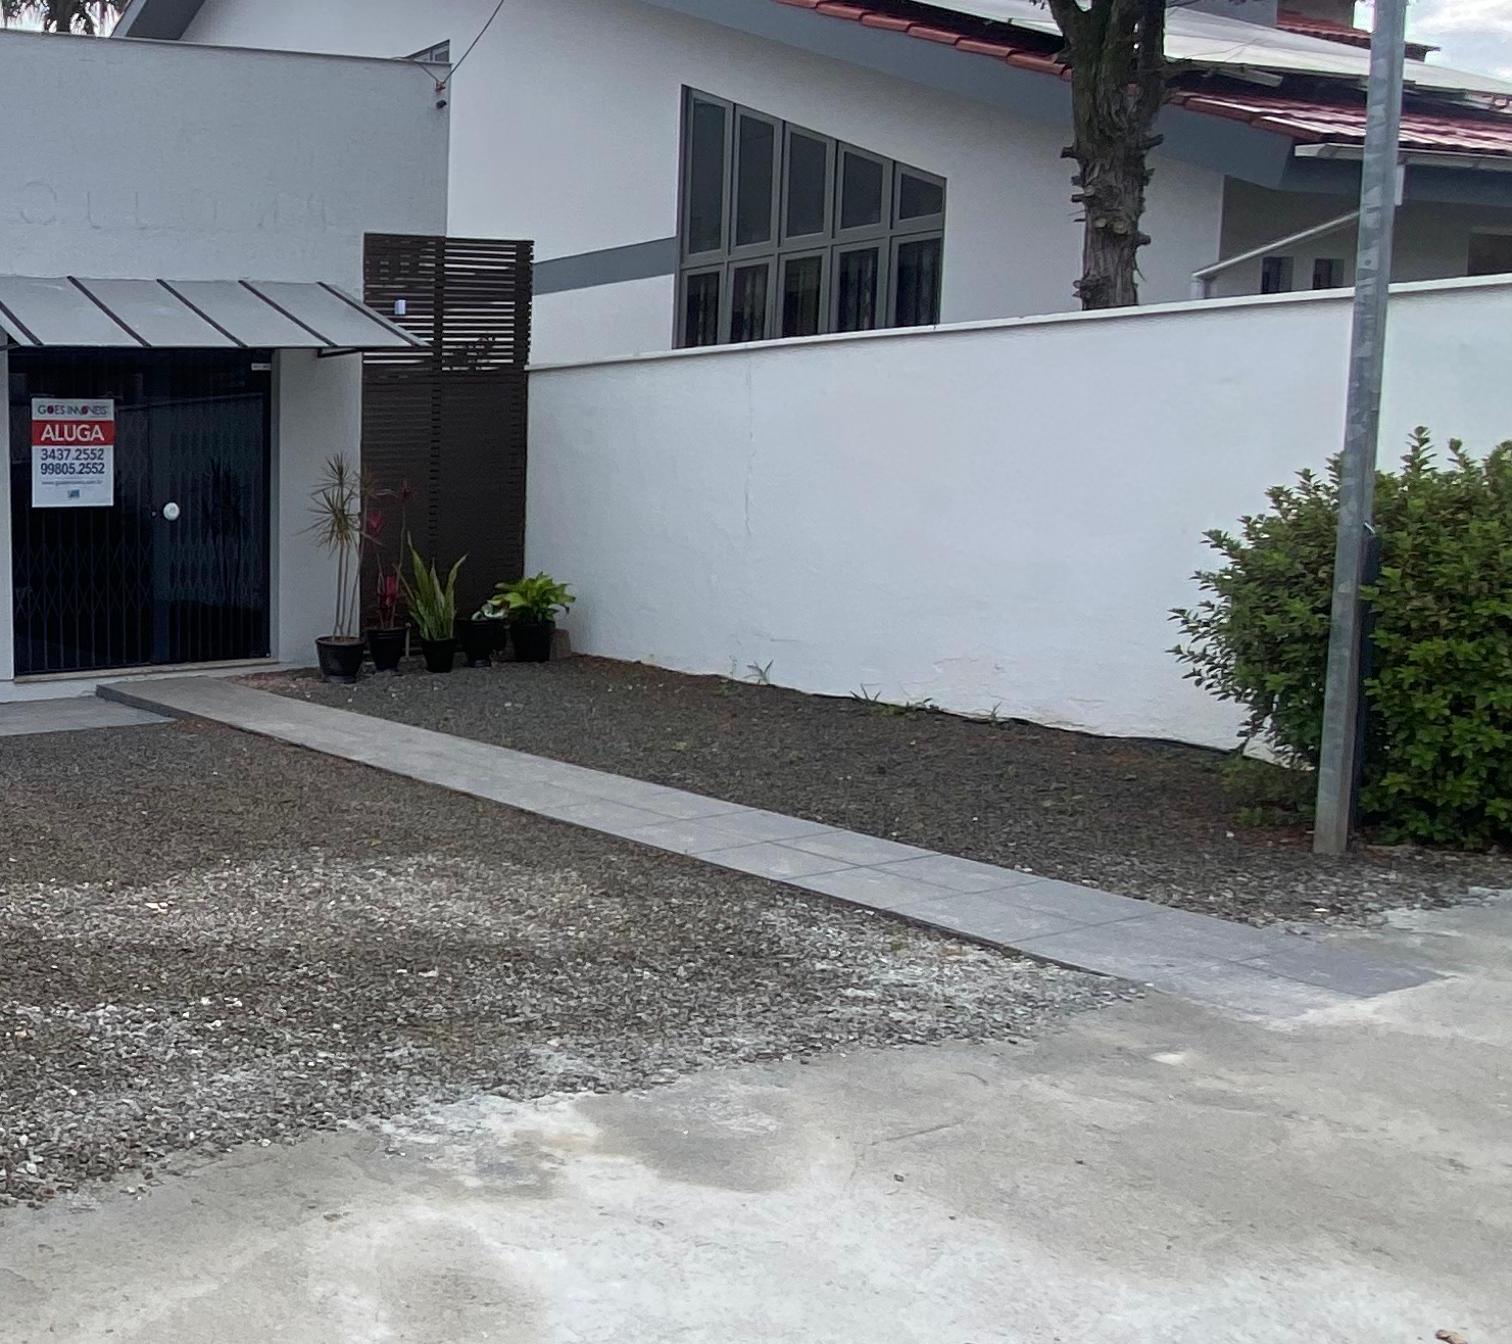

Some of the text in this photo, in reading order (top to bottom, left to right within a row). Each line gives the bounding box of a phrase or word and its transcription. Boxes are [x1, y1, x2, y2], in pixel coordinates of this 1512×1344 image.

[40, 424, 105, 441] ALUGA
[40, 448, 105, 461] 3437.2552
[40, 462, 105, 475] 99805.2552
